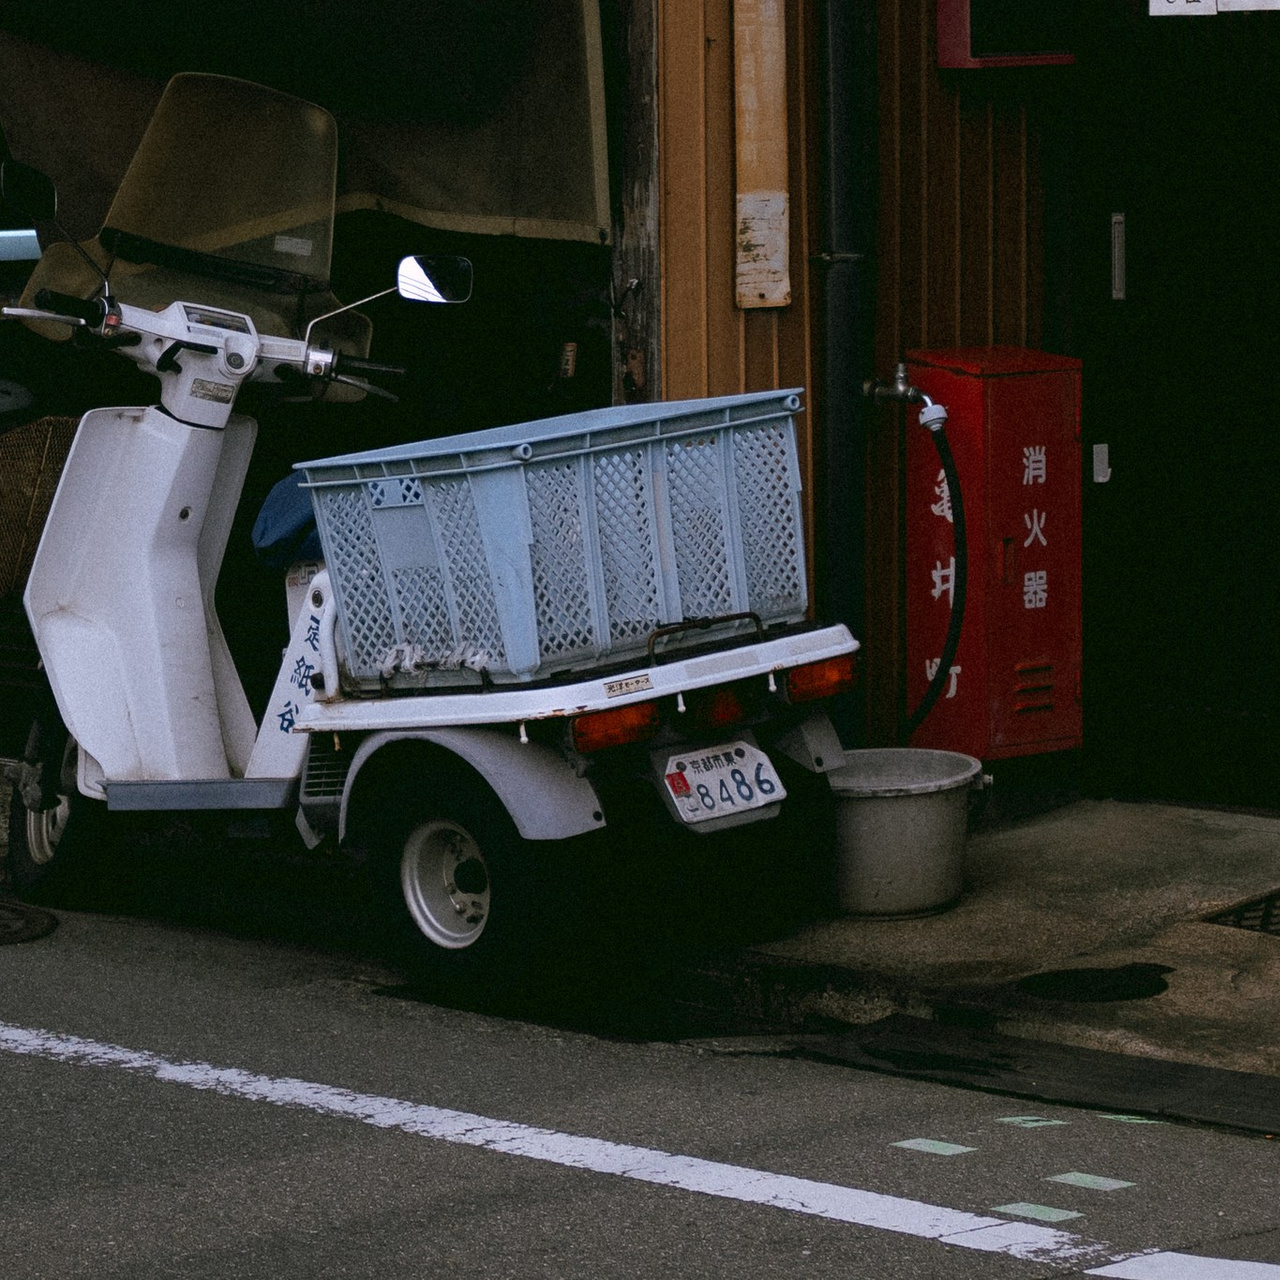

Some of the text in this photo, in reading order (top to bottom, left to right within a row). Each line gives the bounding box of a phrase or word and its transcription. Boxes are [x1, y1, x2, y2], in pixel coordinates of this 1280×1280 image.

[1022, 445, 1049, 610] 消火器
[689, 751, 737, 774] 京都市東
[696, 762, 776, 811] 8486
